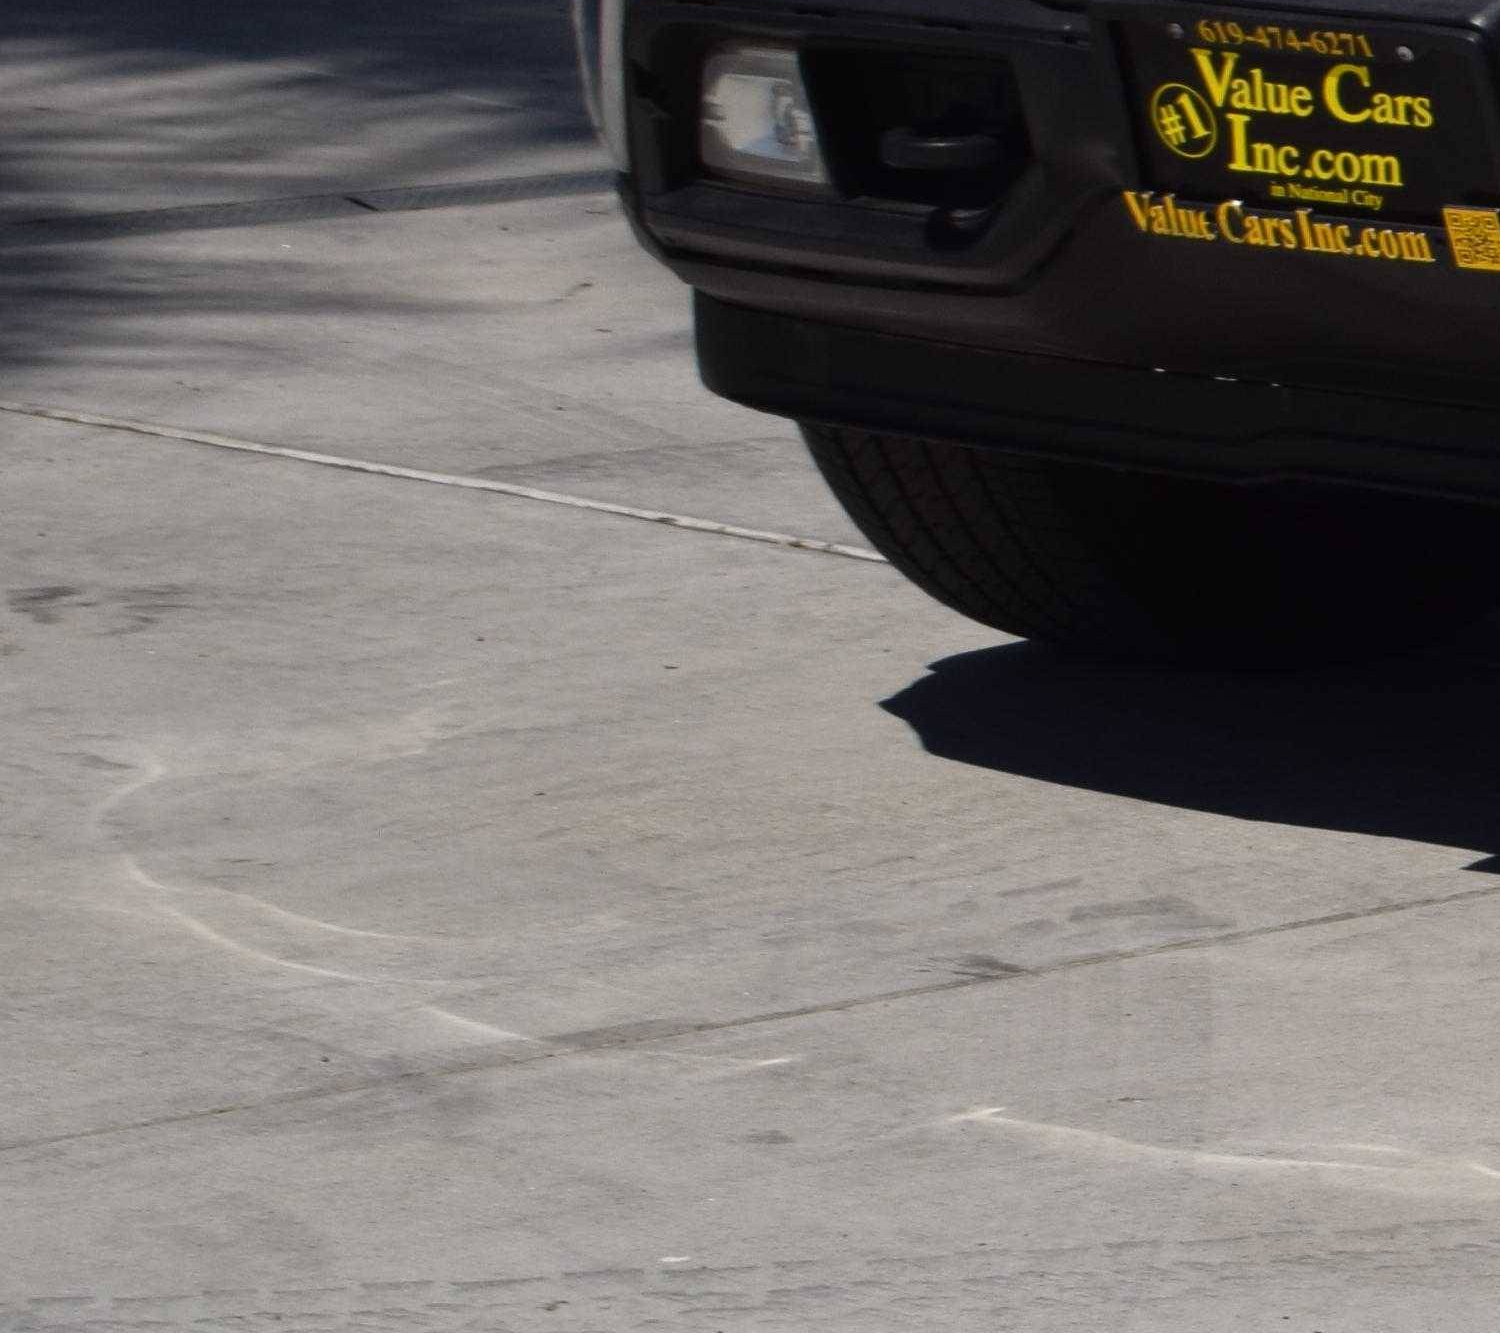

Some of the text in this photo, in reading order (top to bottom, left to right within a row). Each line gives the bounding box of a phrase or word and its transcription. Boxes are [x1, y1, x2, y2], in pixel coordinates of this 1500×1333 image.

[1160, 91, 1212, 147] #1
[1188, 46, 1434, 128] Value Cars
[1226, 113, 1404, 188] Inc.com
[1352, 189, 1384, 211] City
